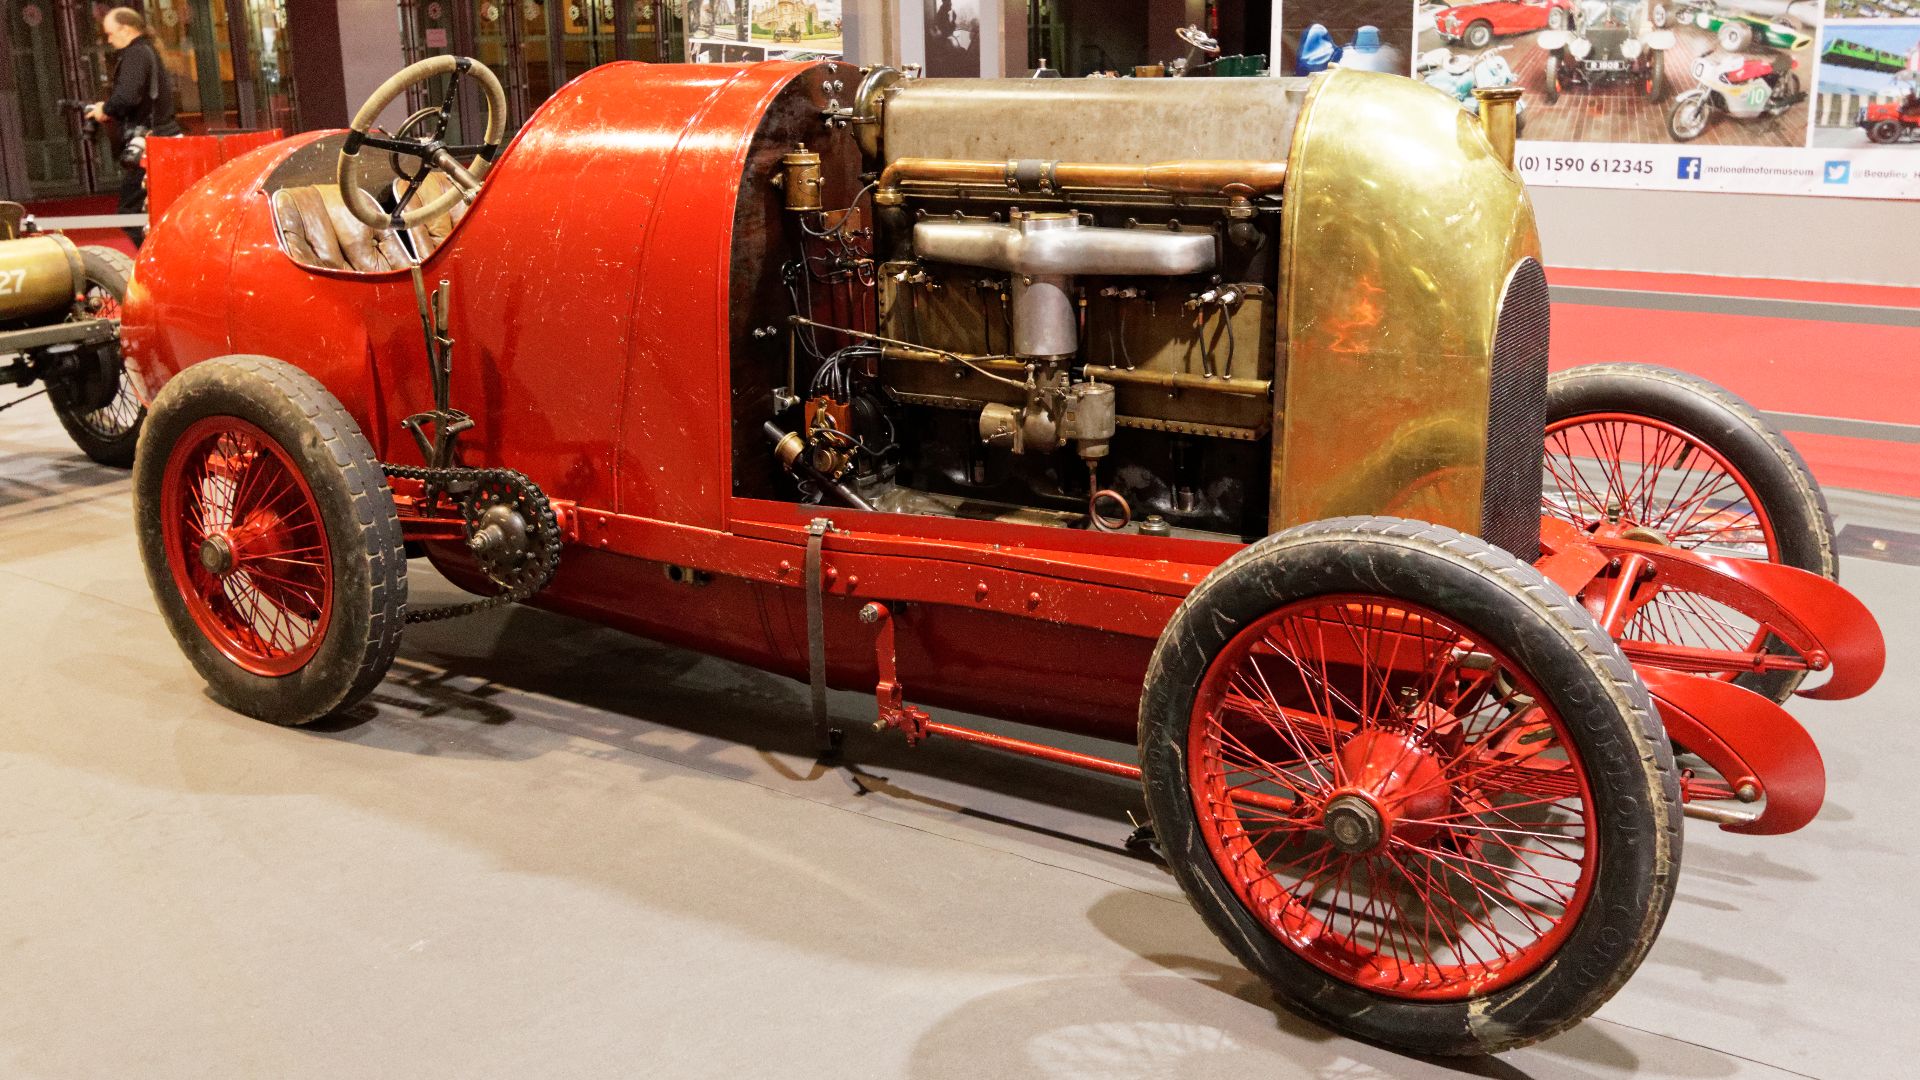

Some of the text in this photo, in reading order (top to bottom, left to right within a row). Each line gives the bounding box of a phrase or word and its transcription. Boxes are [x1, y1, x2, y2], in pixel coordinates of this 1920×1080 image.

[1750, 88, 1765, 105] 10
[1518, 156, 1653, 174] (0) 1590 612345
[0, 269, 26, 295] 27
[1563, 678, 1640, 846] DUNLOP
